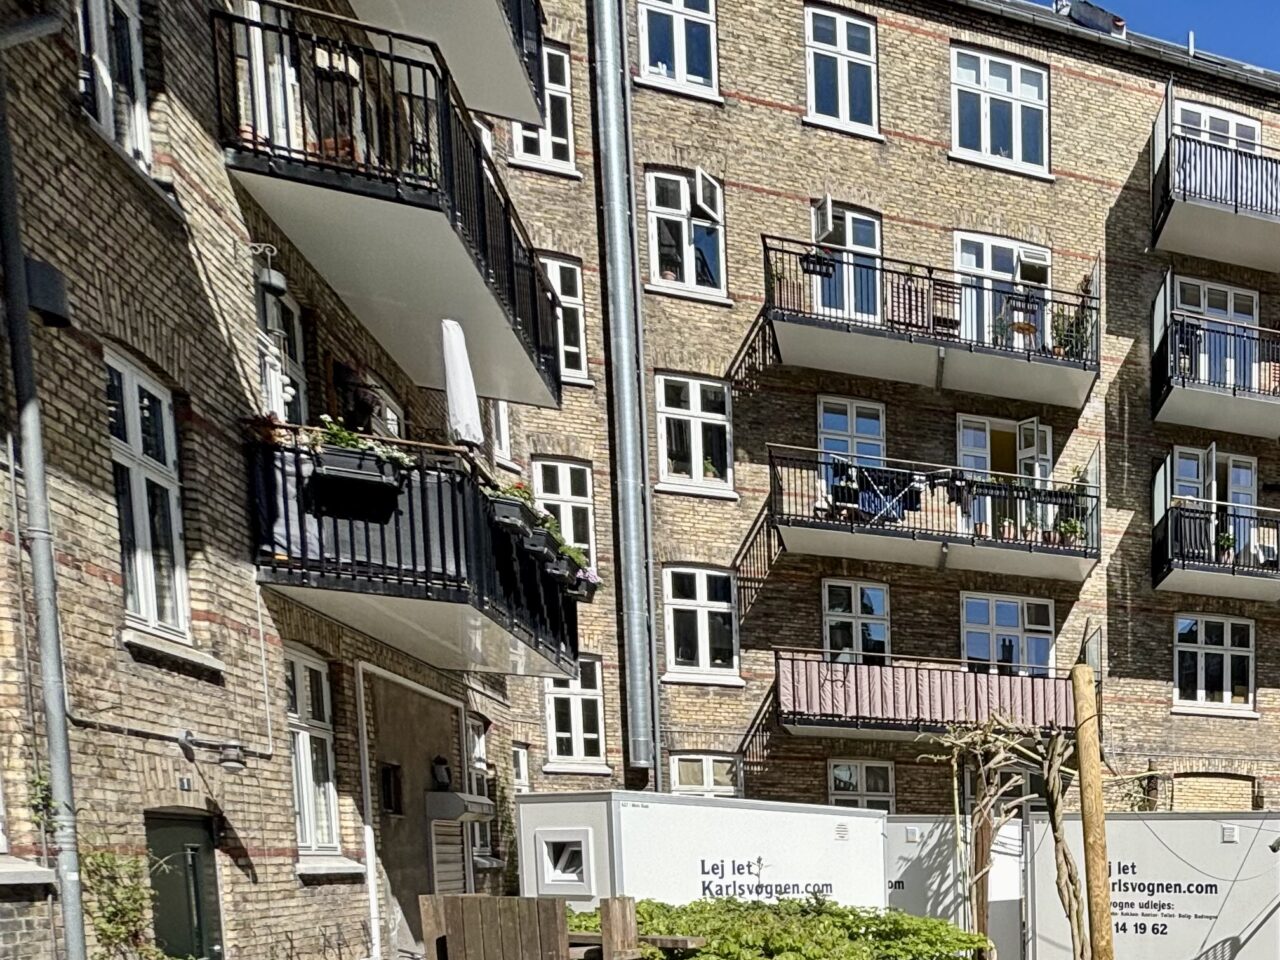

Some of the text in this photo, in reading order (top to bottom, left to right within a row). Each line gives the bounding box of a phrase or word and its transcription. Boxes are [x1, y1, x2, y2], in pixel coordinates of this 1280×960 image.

[701, 859, 753, 879] Lej let
[1117, 861, 1137, 875] let
[702, 880, 833, 899] Karlsvognen.com
[1111, 878, 1218, 897] rlsvognen.com
[1138, 900, 1176, 912] udlejes:
[1114, 921, 1168, 935] 14 19 62
